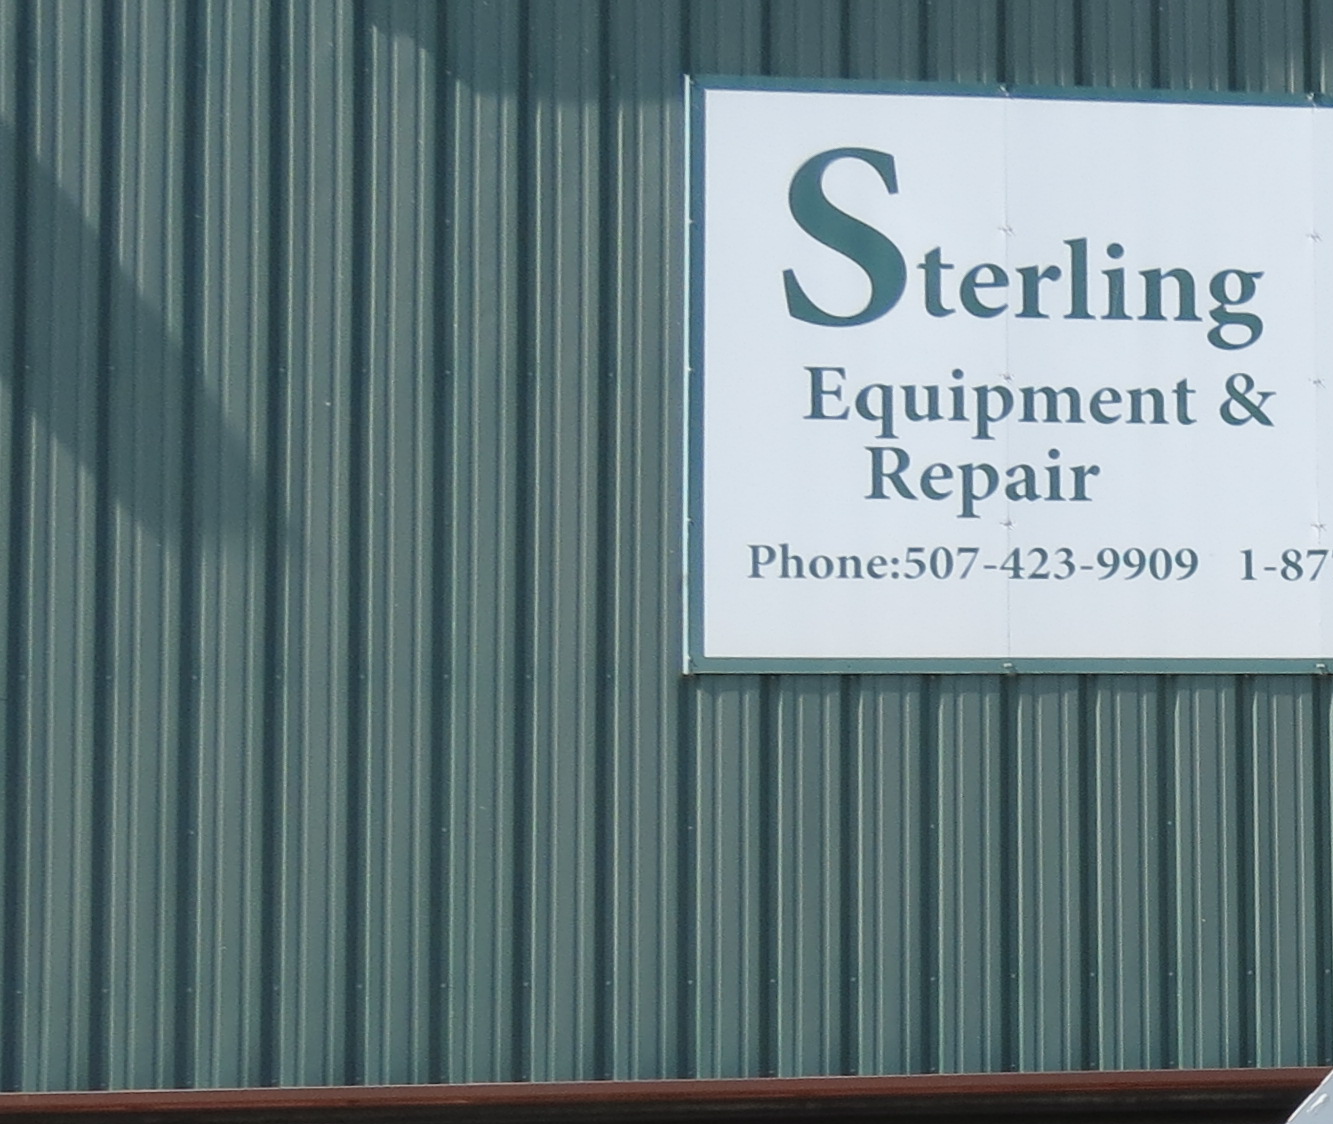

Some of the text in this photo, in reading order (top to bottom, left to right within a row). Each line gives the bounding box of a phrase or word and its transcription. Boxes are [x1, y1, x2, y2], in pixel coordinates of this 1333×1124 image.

[783, 147, 1264, 351] Sterling
[803, 366, 1276, 440] Equipment &
[865, 446, 1101, 519] Repair
[748, 543, 1199, 582] Phone:507-423-9909
